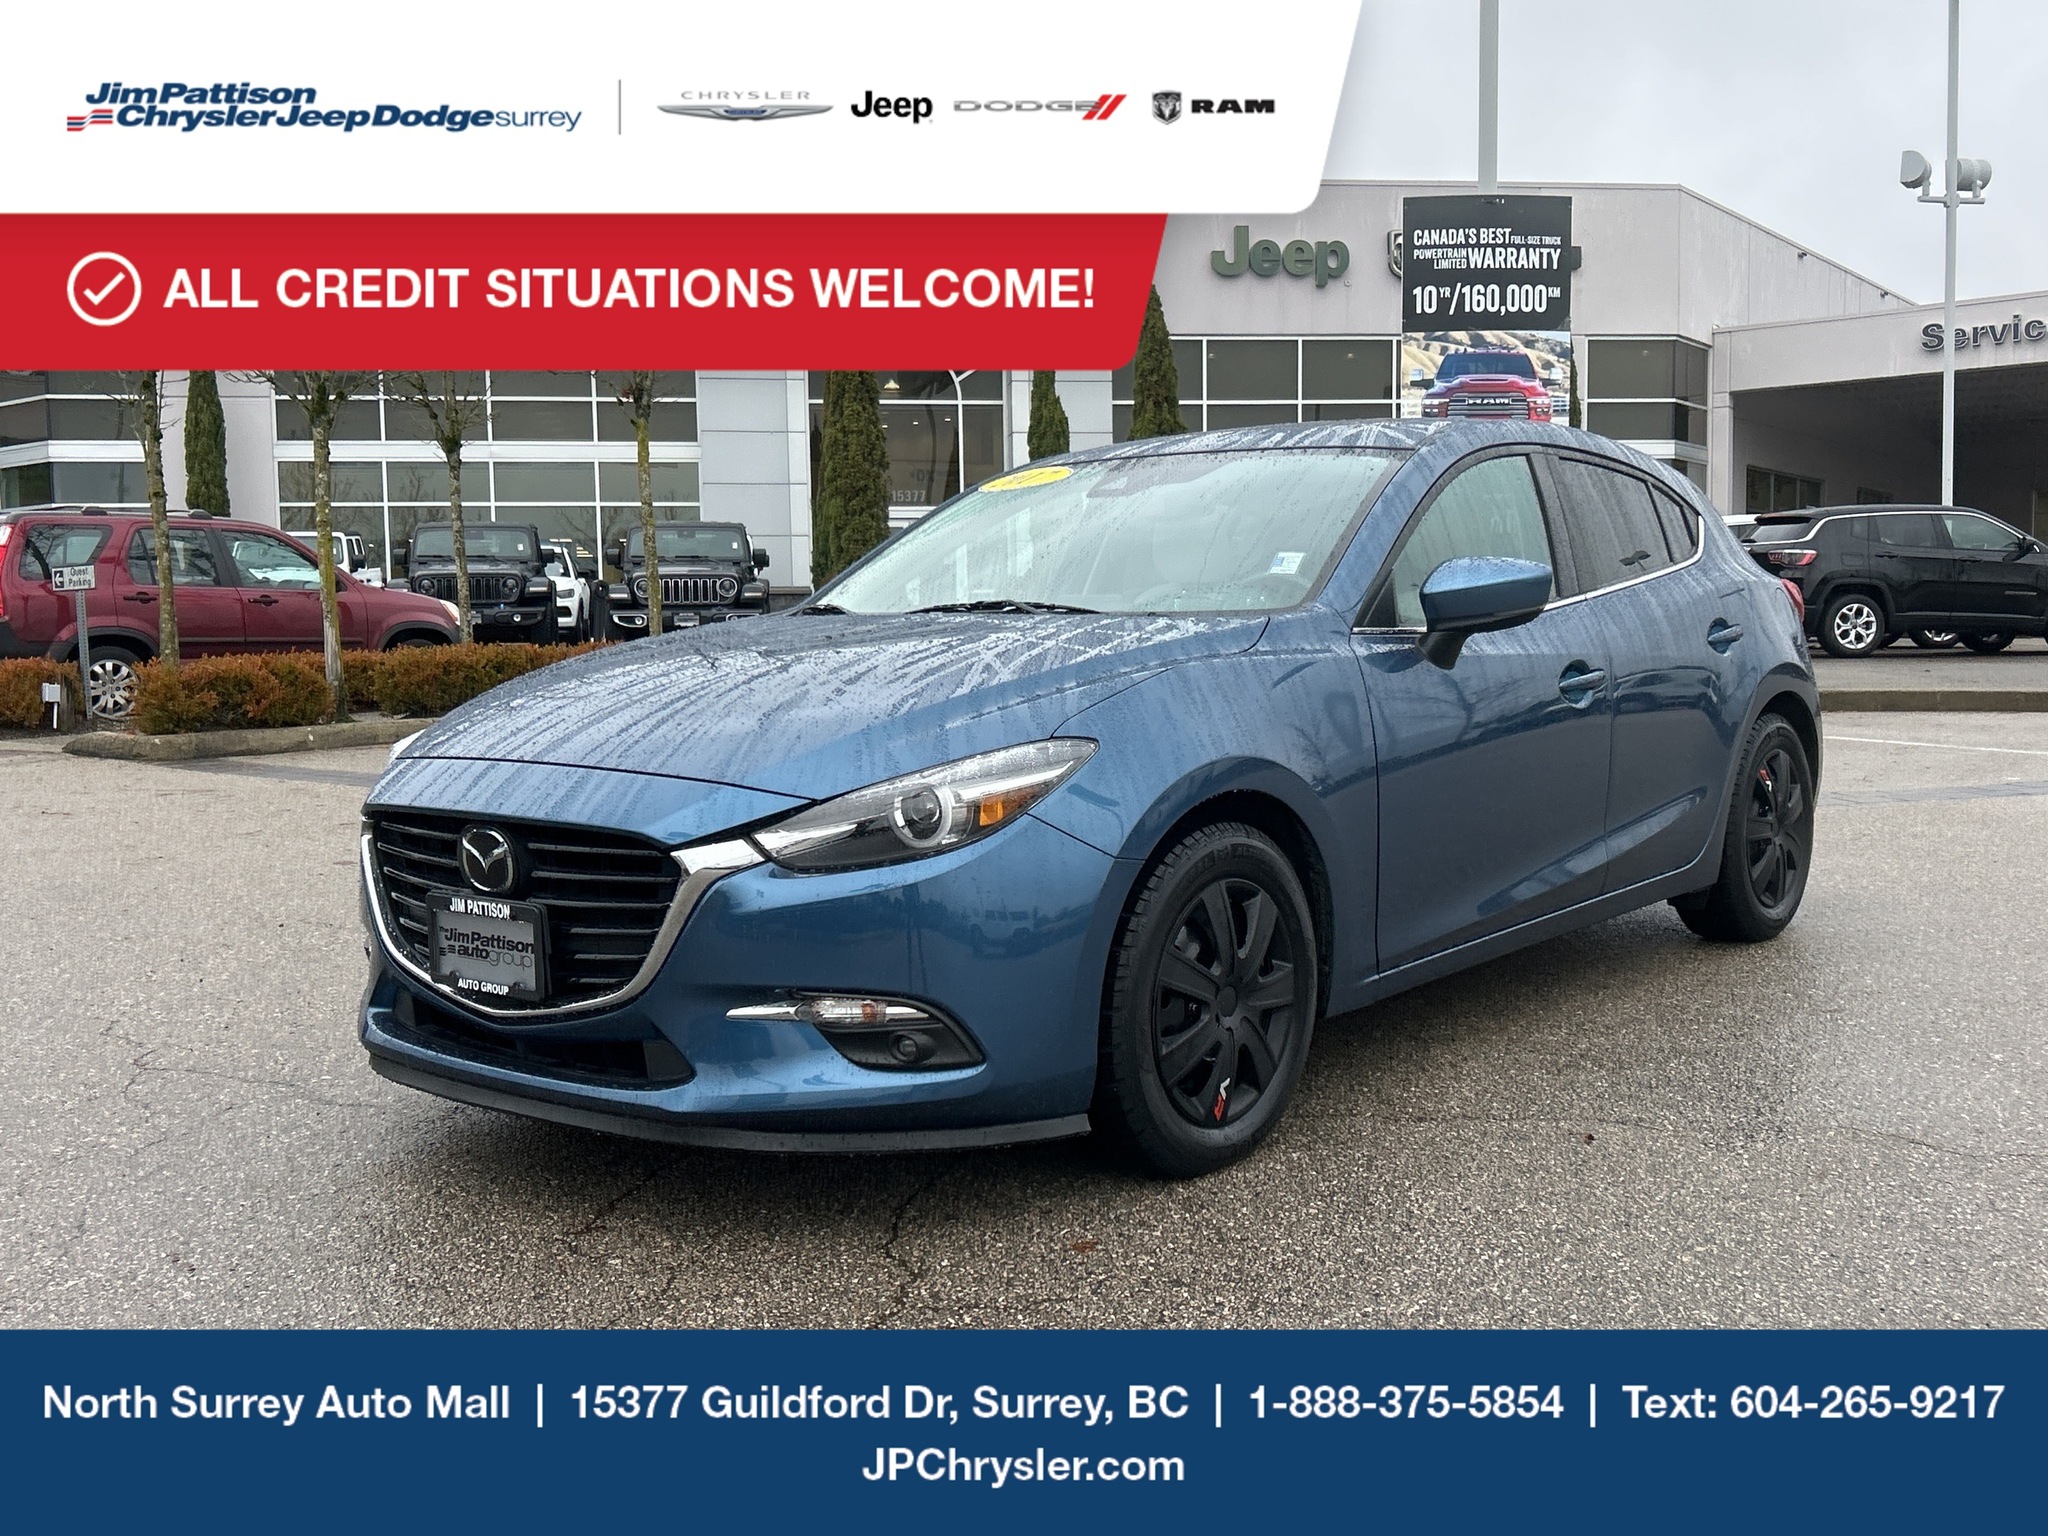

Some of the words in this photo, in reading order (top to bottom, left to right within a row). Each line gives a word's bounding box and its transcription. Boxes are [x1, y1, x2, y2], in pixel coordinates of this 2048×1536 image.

[1413, 228, 1477, 246] CANADA'S
[1479, 228, 1511, 244] BEST
[1510, 235, 1541, 245] FULL-SIZE
[1541, 236, 1561, 245] TRUCK
[1211, 225, 1350, 288] Jeep
[1413, 248, 1467, 260] POWERTRAIN
[1467, 247, 1561, 270] WARRANTY
[1433, 258, 1467, 269] LIMITED
[1921, 314, 2048, 351] Servic
[891, 489, 926, 502] 15377
[70, 566, 89, 577] Guest
[68, 577, 92, 589] Parking
[449, 897, 466, 914] JIM
[466, 899, 510, 919] PATTISON
[457, 978, 480, 991] AUTO
[480, 981, 510, 996] GROUP
